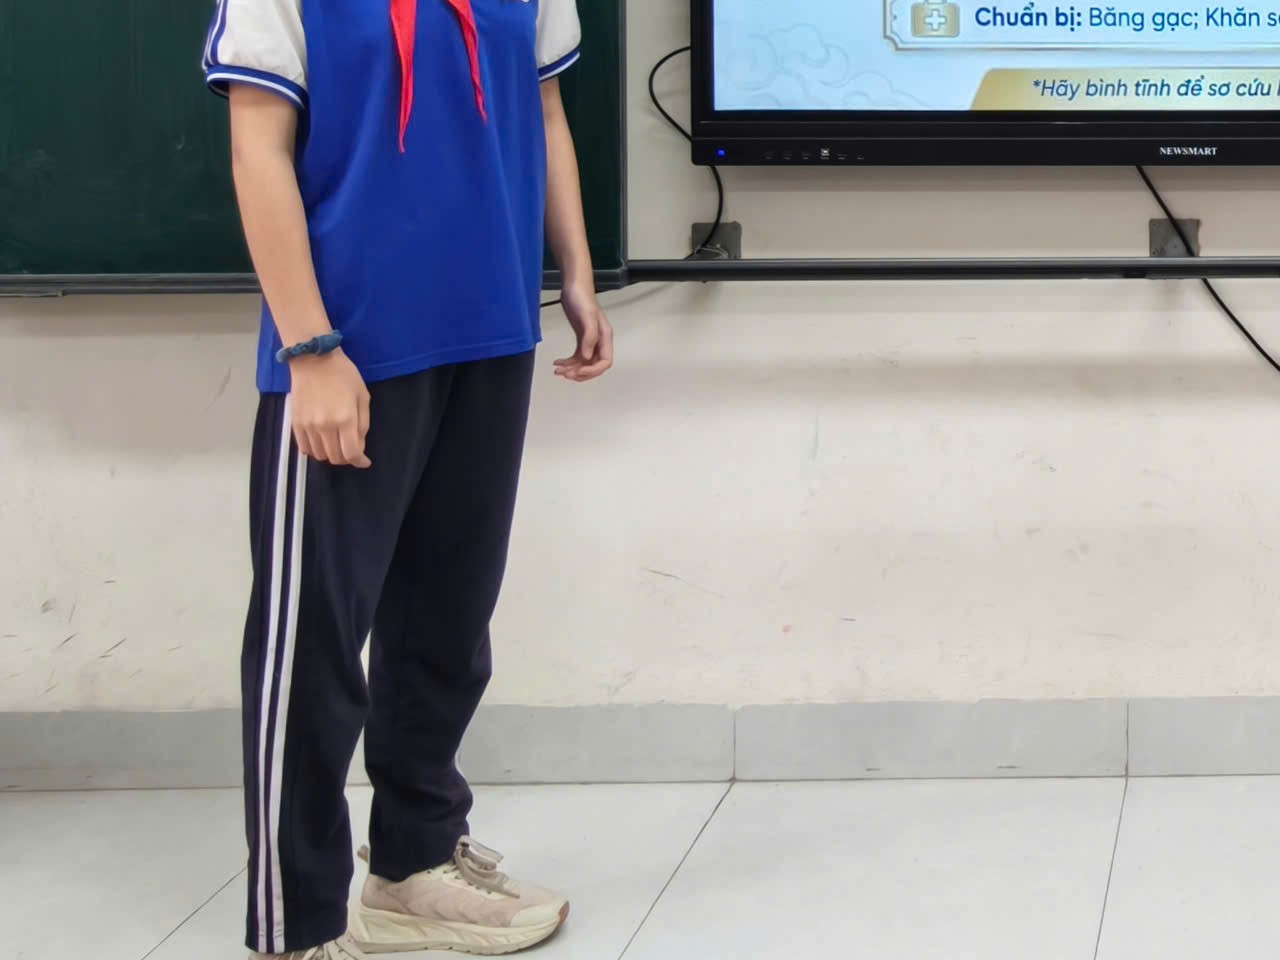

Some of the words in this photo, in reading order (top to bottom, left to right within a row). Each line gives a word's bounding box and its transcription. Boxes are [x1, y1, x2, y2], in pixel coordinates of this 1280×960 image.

[975, 1, 1048, 27] Chuẩn
[1055, 6, 1082, 32] bị:
[1089, 7, 1145, 32] Băng
[1151, 11, 1199, 32] gạc;
[1206, 7, 1261, 27] Khăn
[1085, 78, 1128, 97] bình
[1134, 78, 1171, 97] tĩnh
[1176, 74, 1205, 97] để
[1207, 80, 1231, 97] sơ
[1235, 78, 1272, 97] cứu
[1159, 146, 1217, 156] NEWSMART
